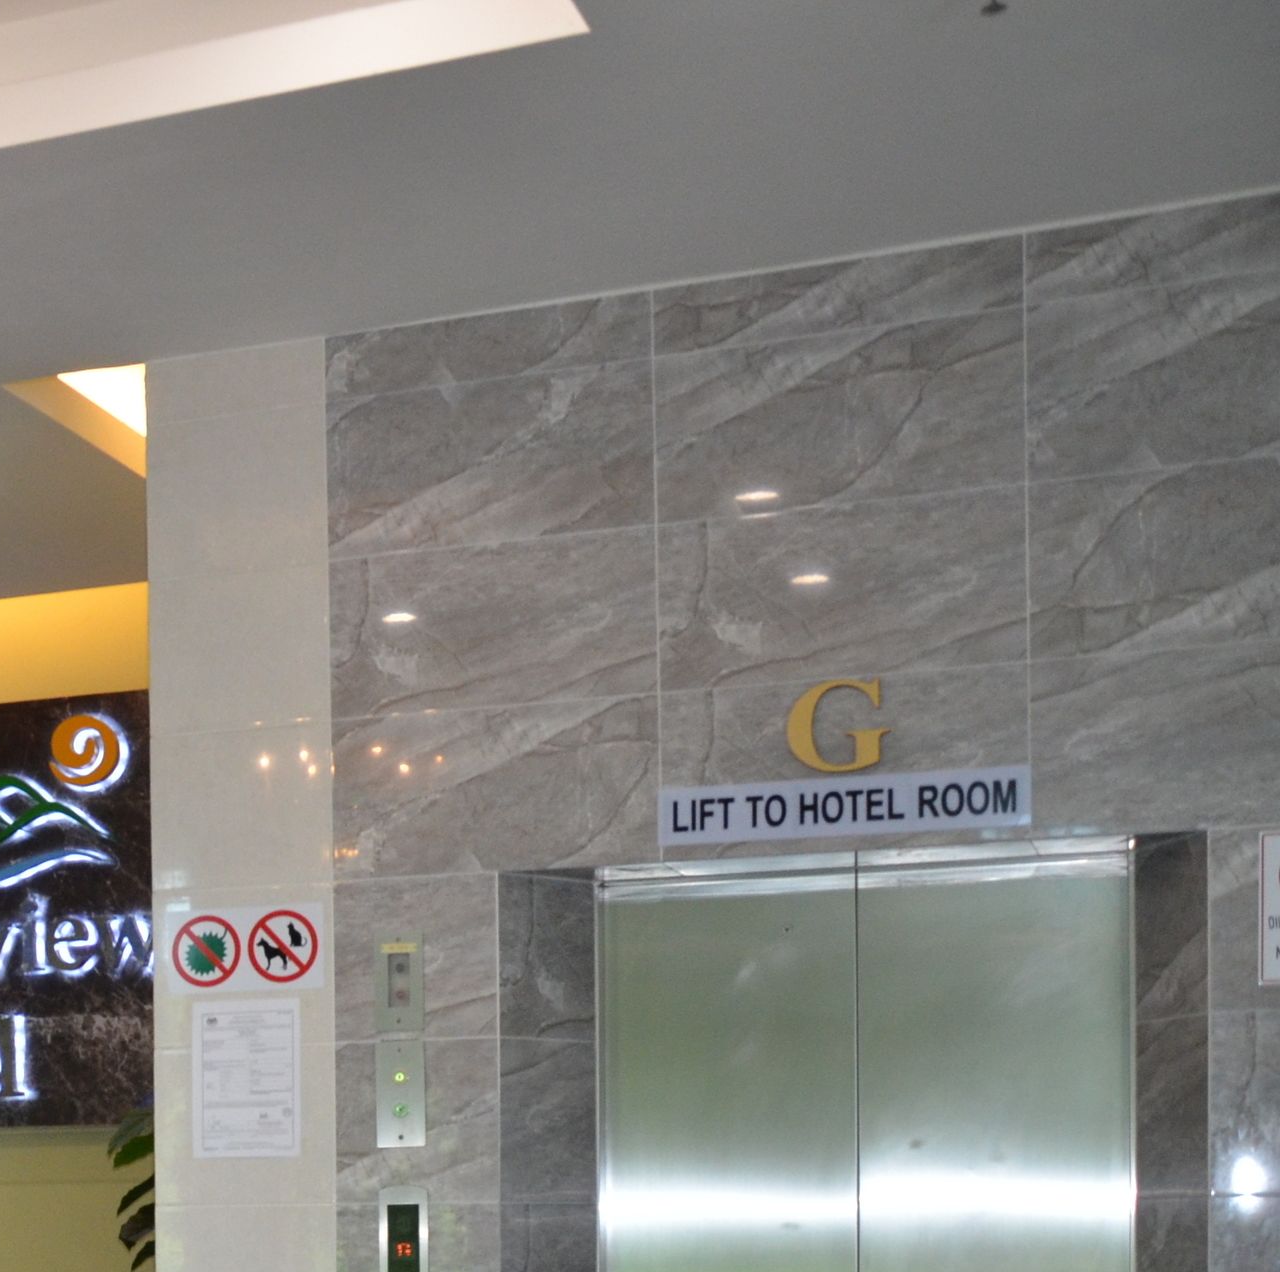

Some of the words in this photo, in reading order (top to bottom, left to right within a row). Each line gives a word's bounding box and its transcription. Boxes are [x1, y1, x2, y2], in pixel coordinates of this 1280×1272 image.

[786, 677, 892, 774] G
[672, 797, 735, 833] LIFT
[746, 793, 787, 829] TO
[798, 787, 905, 825] HOTEL
[918, 779, 1018, 819] ROOM
